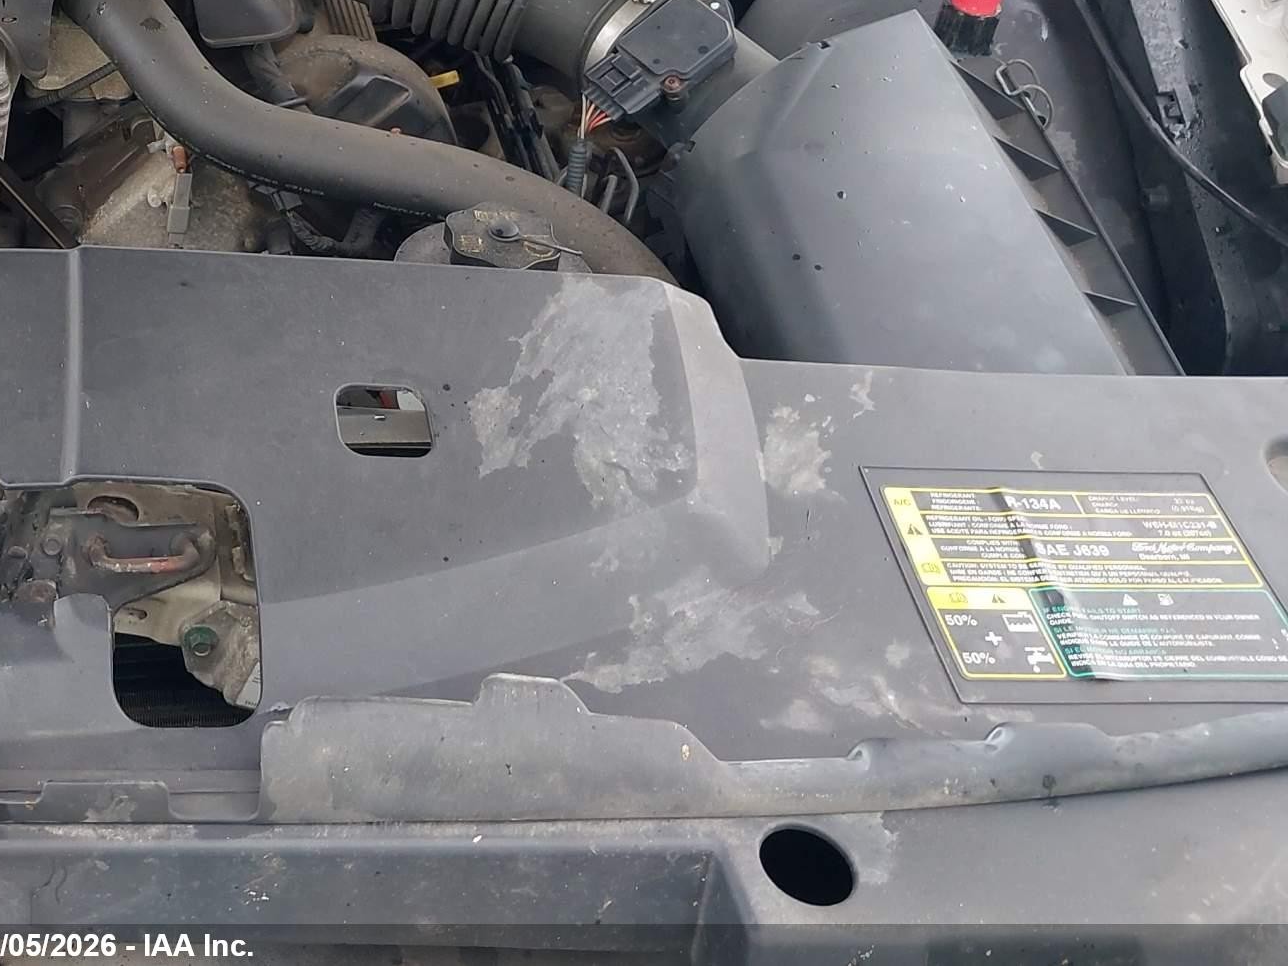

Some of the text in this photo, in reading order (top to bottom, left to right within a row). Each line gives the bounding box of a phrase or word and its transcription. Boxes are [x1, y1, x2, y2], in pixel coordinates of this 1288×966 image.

[1004, 495, 1062, 511] R-134A
[1034, 542, 1111, 557] SAE J639
[945, 614, 978, 626] 50%
[962, 652, 996, 664] 50%
